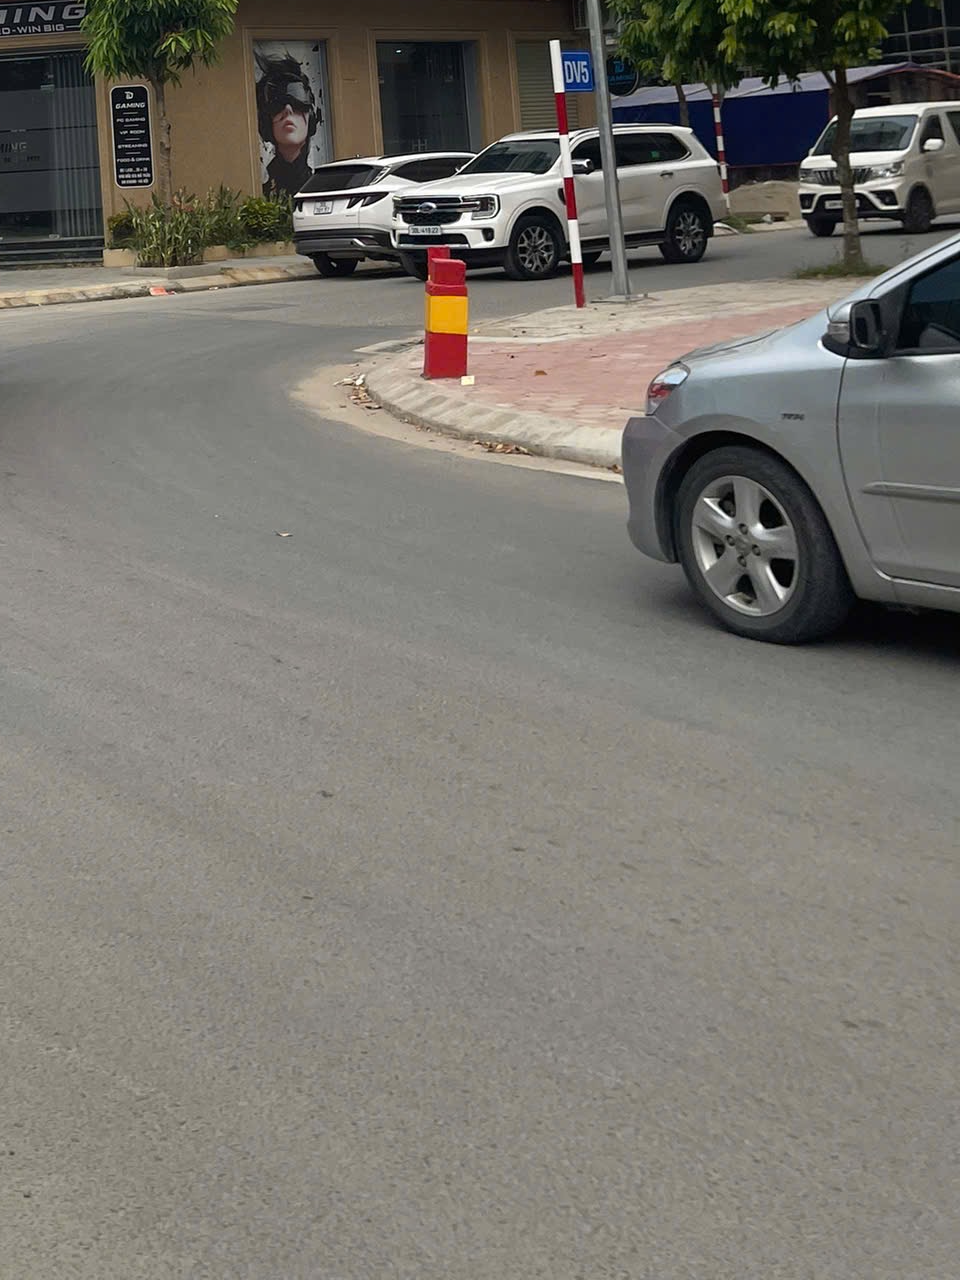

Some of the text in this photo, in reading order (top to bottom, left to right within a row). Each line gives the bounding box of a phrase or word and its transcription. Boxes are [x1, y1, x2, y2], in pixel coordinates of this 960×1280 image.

[43, 24, 65, 32] BIG
[564, 61, 590, 83] DV5
[115, 102, 146, 110] GAMING
